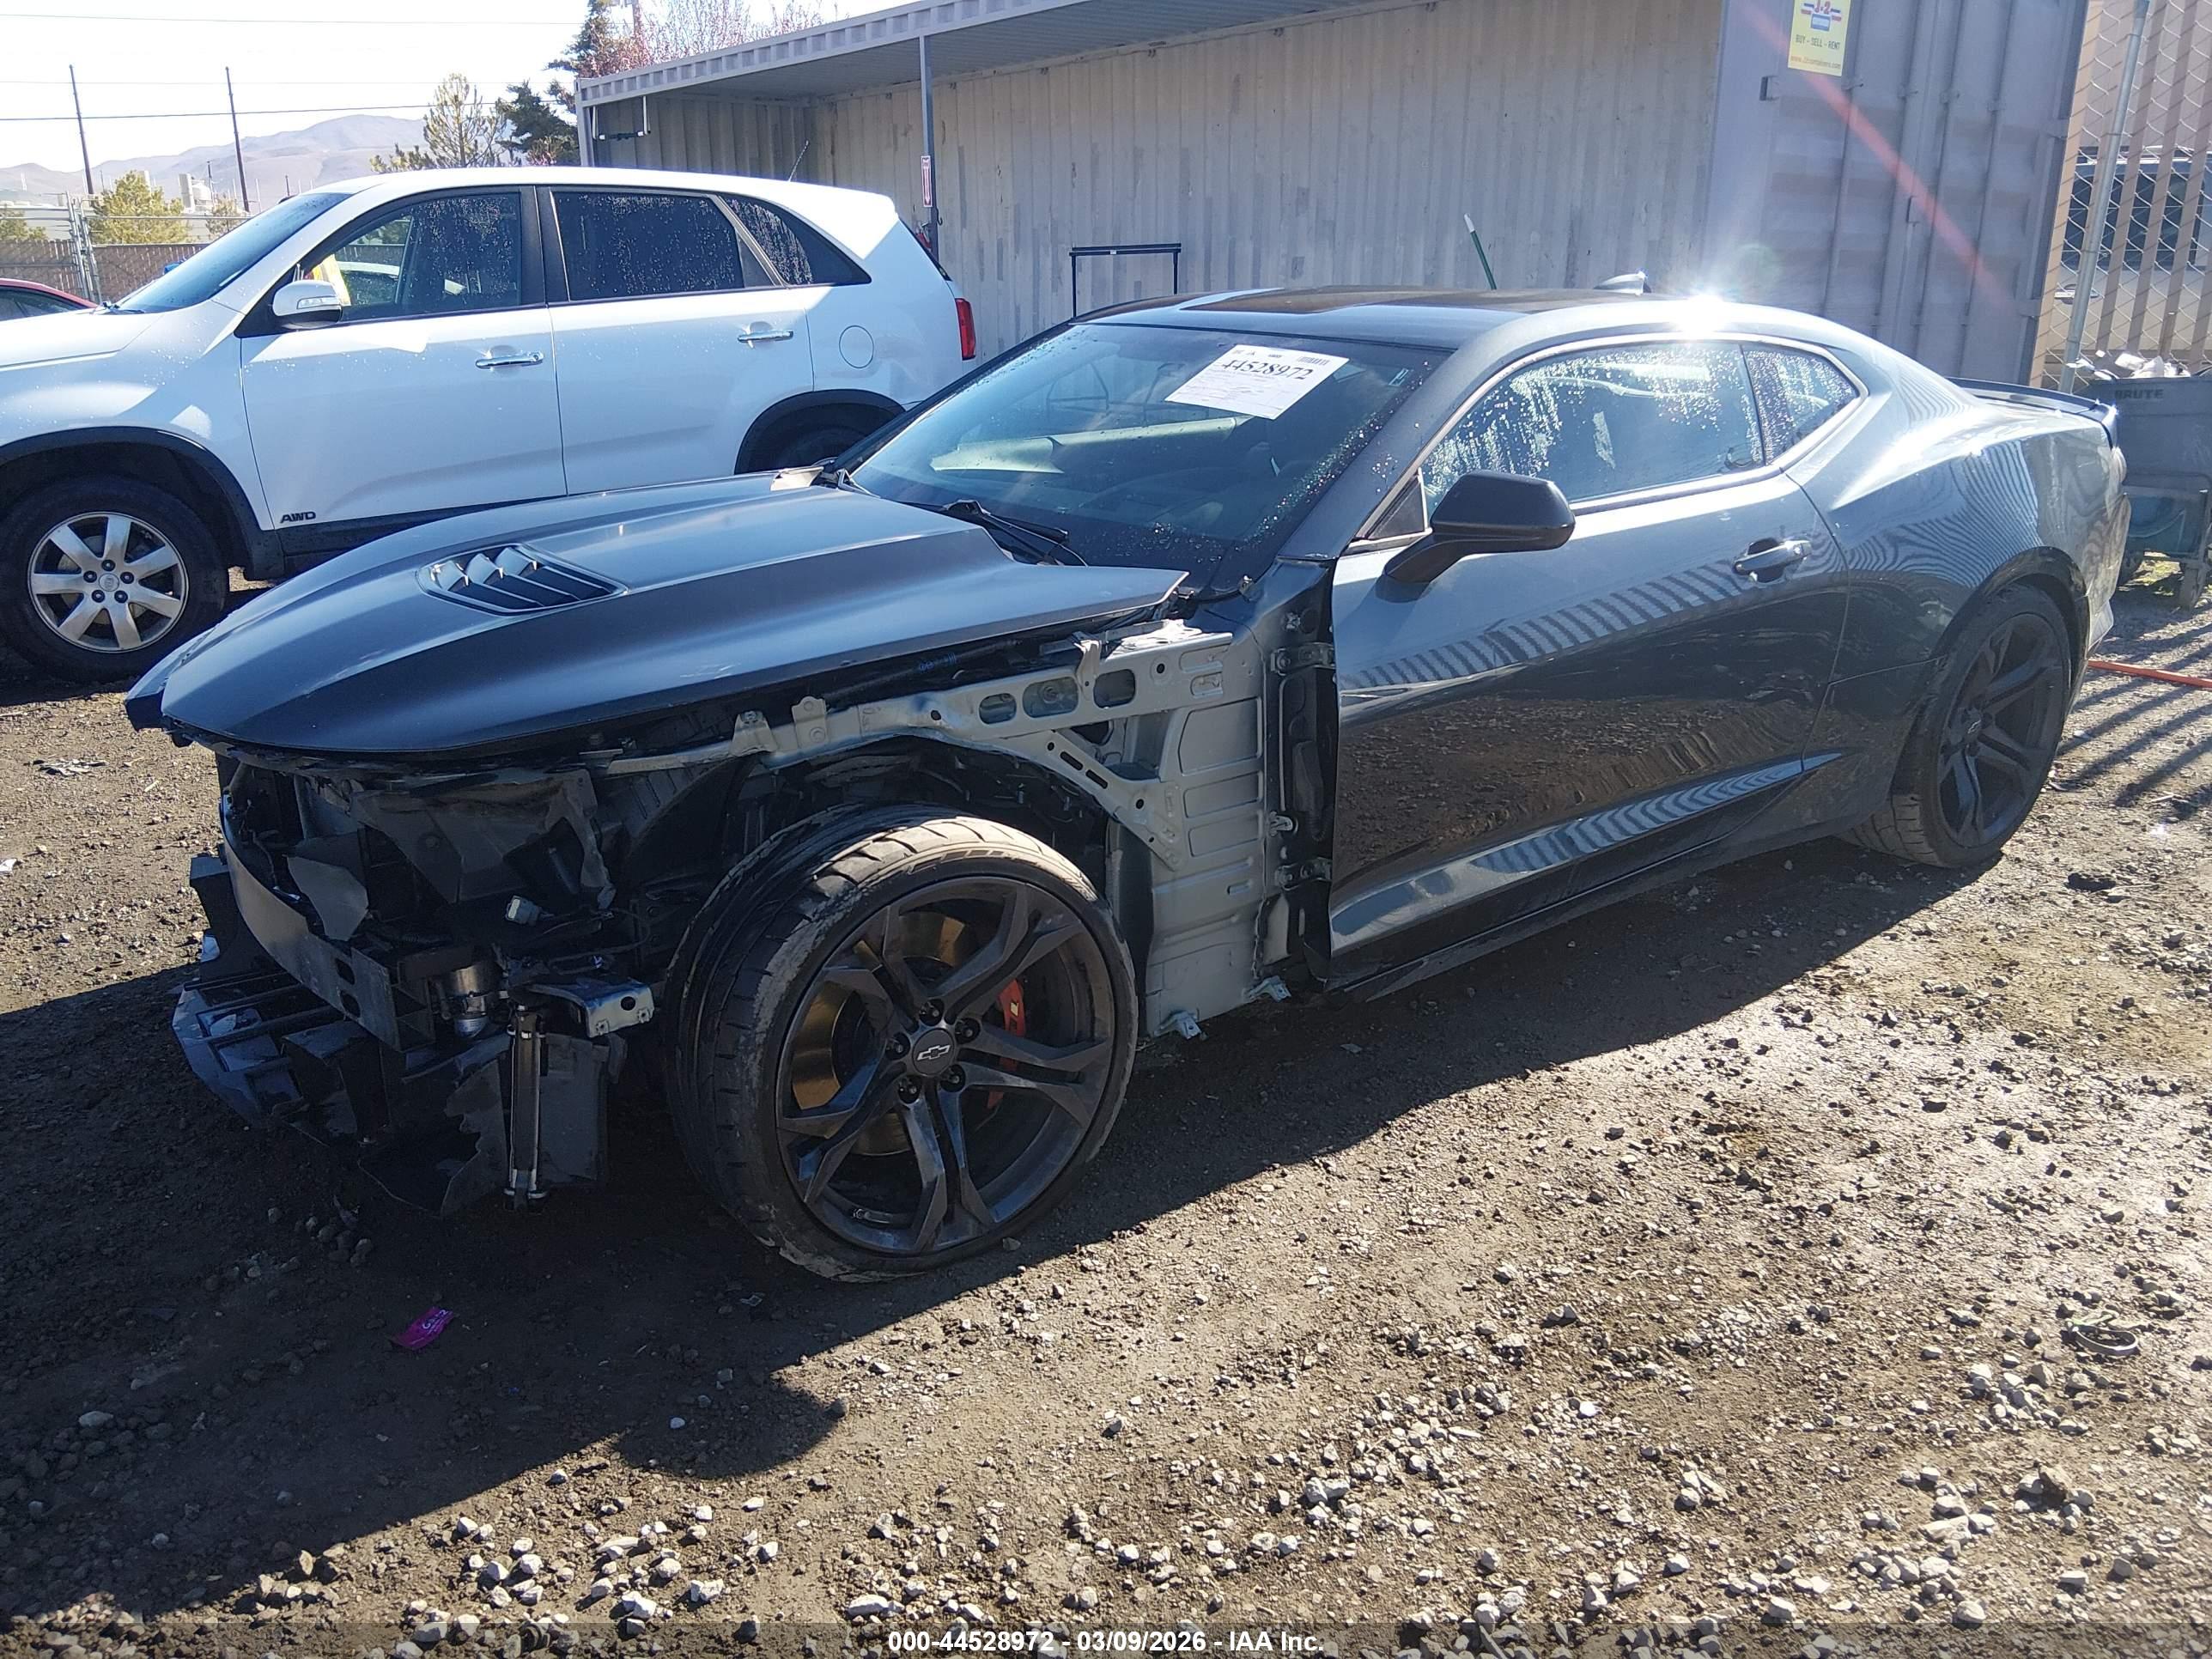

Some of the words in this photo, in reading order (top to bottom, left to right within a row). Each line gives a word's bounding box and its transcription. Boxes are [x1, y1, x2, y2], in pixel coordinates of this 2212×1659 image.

[1796, 34, 1806, 45] BUY
[1811, 37, 1822, 47] SELL
[1828, 40, 1841, 50] RENT
[1222, 359, 1314, 380] 44528972
[280, 511, 317, 524] AWD
